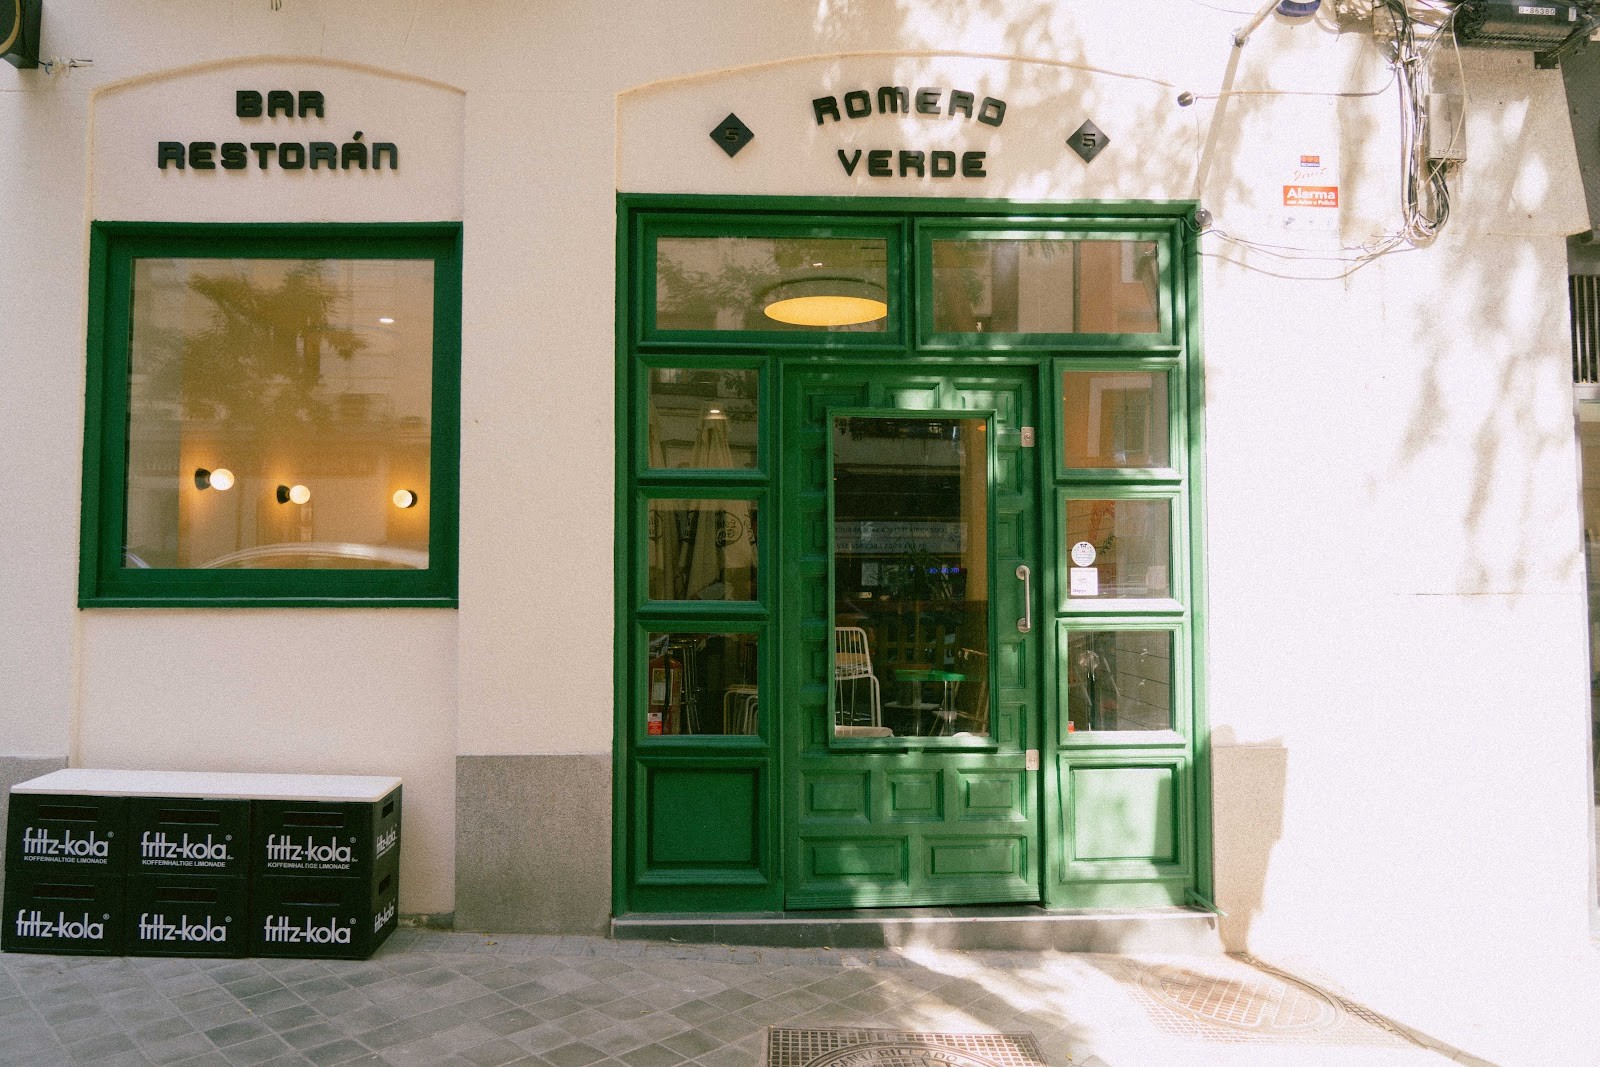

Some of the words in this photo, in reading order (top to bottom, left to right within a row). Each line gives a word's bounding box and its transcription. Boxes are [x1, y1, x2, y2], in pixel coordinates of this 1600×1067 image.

[235, 90, 325, 119] BAR
[812, 86, 1007, 128] ROMERO
[157, 130, 398, 171] RESTORÁN
[1082, 133, 1096, 149] 5
[837, 149, 987, 178] VERDE
[1286, 187, 1336, 200] Alarma
[23, 827, 109, 857] fritz-kola
[141, 831, 227, 860] fritz-kola
[76, 857, 108, 865] LIMONADE
[142, 859, 193, 867] KOFFEINHALTIGE
[194, 860, 226, 868] LIMONADE
[16, 909, 104, 940] fritz-kola
[138, 912, 226, 942] fritz-kola
[264, 914, 351, 944] fritz-kola
